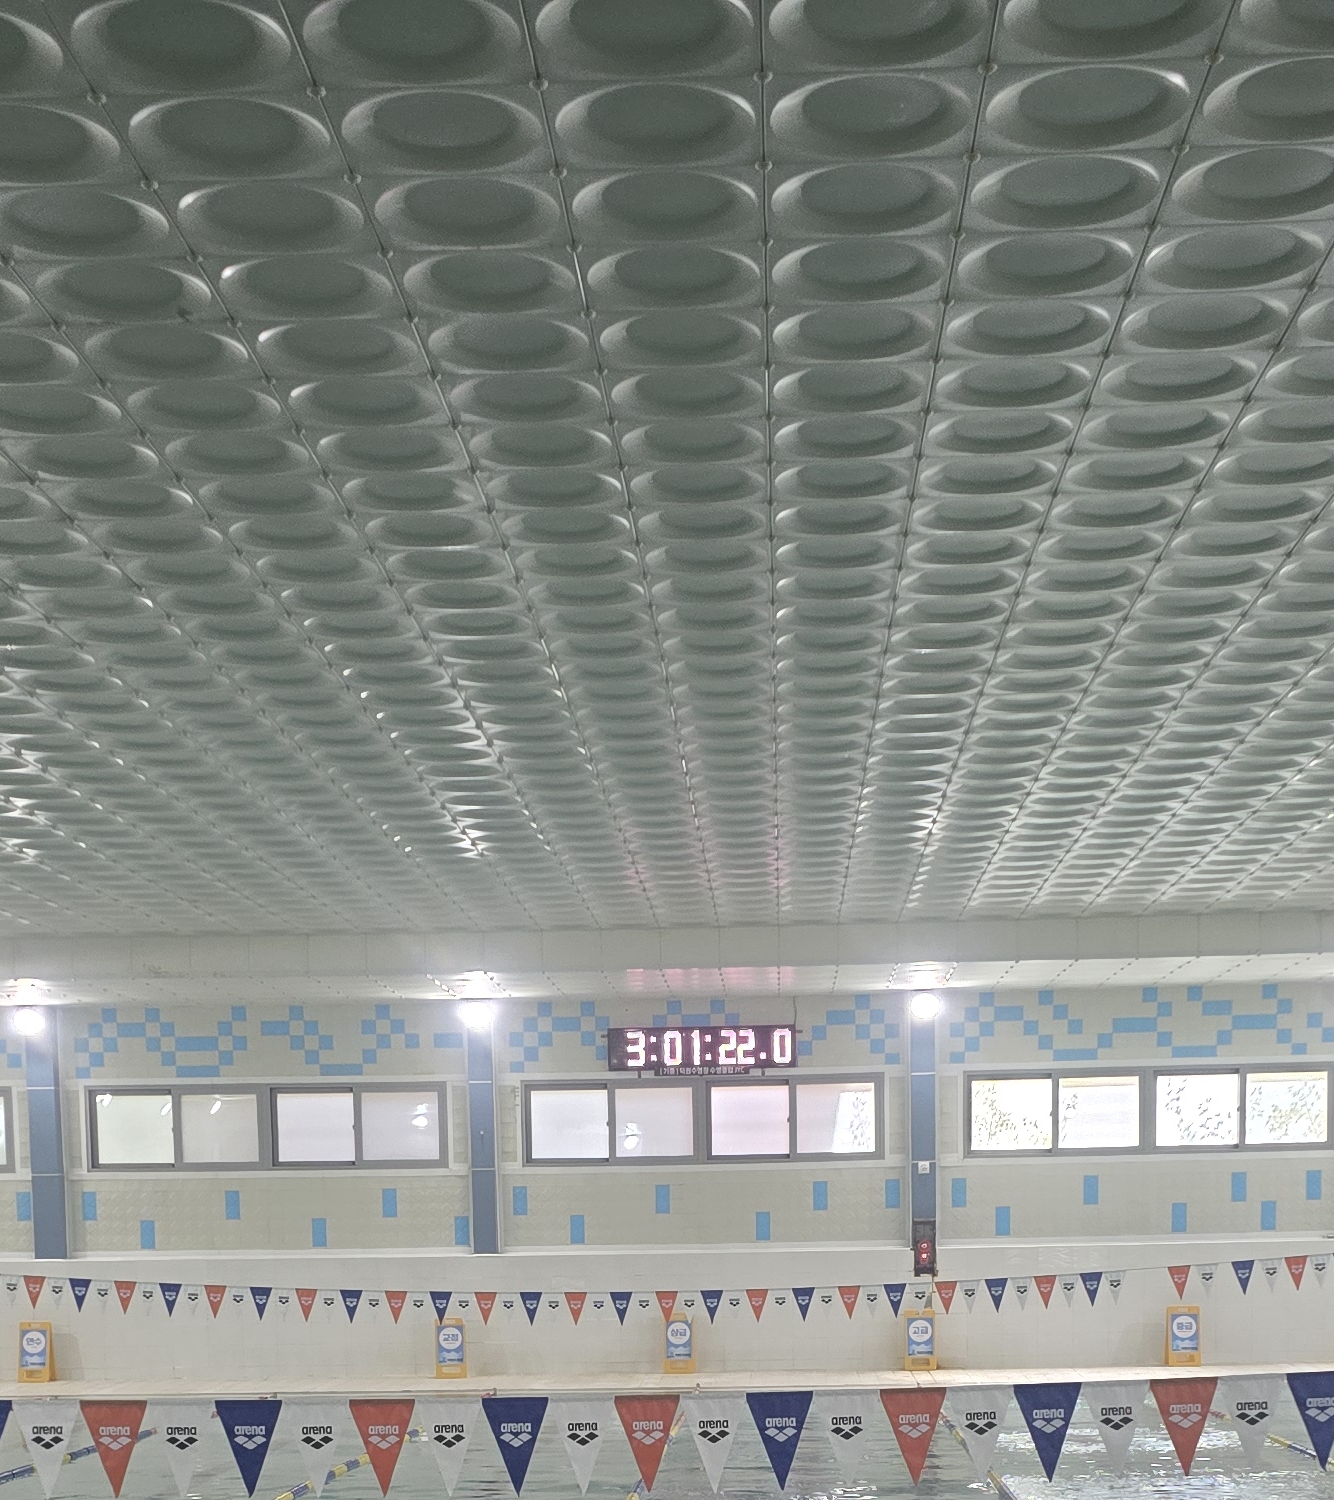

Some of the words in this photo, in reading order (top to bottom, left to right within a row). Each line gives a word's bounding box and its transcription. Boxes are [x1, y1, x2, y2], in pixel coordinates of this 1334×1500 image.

[626, 1028, 792, 1067] 3:01:22.0
[1169, 1403, 1201, 1414] arena
[1236, 1401, 1268, 1411] arena
[965, 1411, 996, 1421] arena
[1032, 1409, 1065, 1419] arena
[1100, 1407, 1132, 1417] arena
[766, 1417, 797, 1427] arena
[831, 1416, 862, 1426] arena
[898, 1413, 930, 1424] arena
[434, 1423, 464, 1433] arena
[500, 1423, 531, 1433] arena
[567, 1422, 597, 1432] arena
[632, 1420, 664, 1431] arena
[699, 1419, 729, 1429] arena
[32, 1425, 62, 1435] arena
[99, 1426, 130, 1436] arena
[167, 1426, 197, 1436] arena
[234, 1425, 265, 1436] arena
[302, 1425, 333, 1434] arena
[368, 1424, 399, 1435] arena
